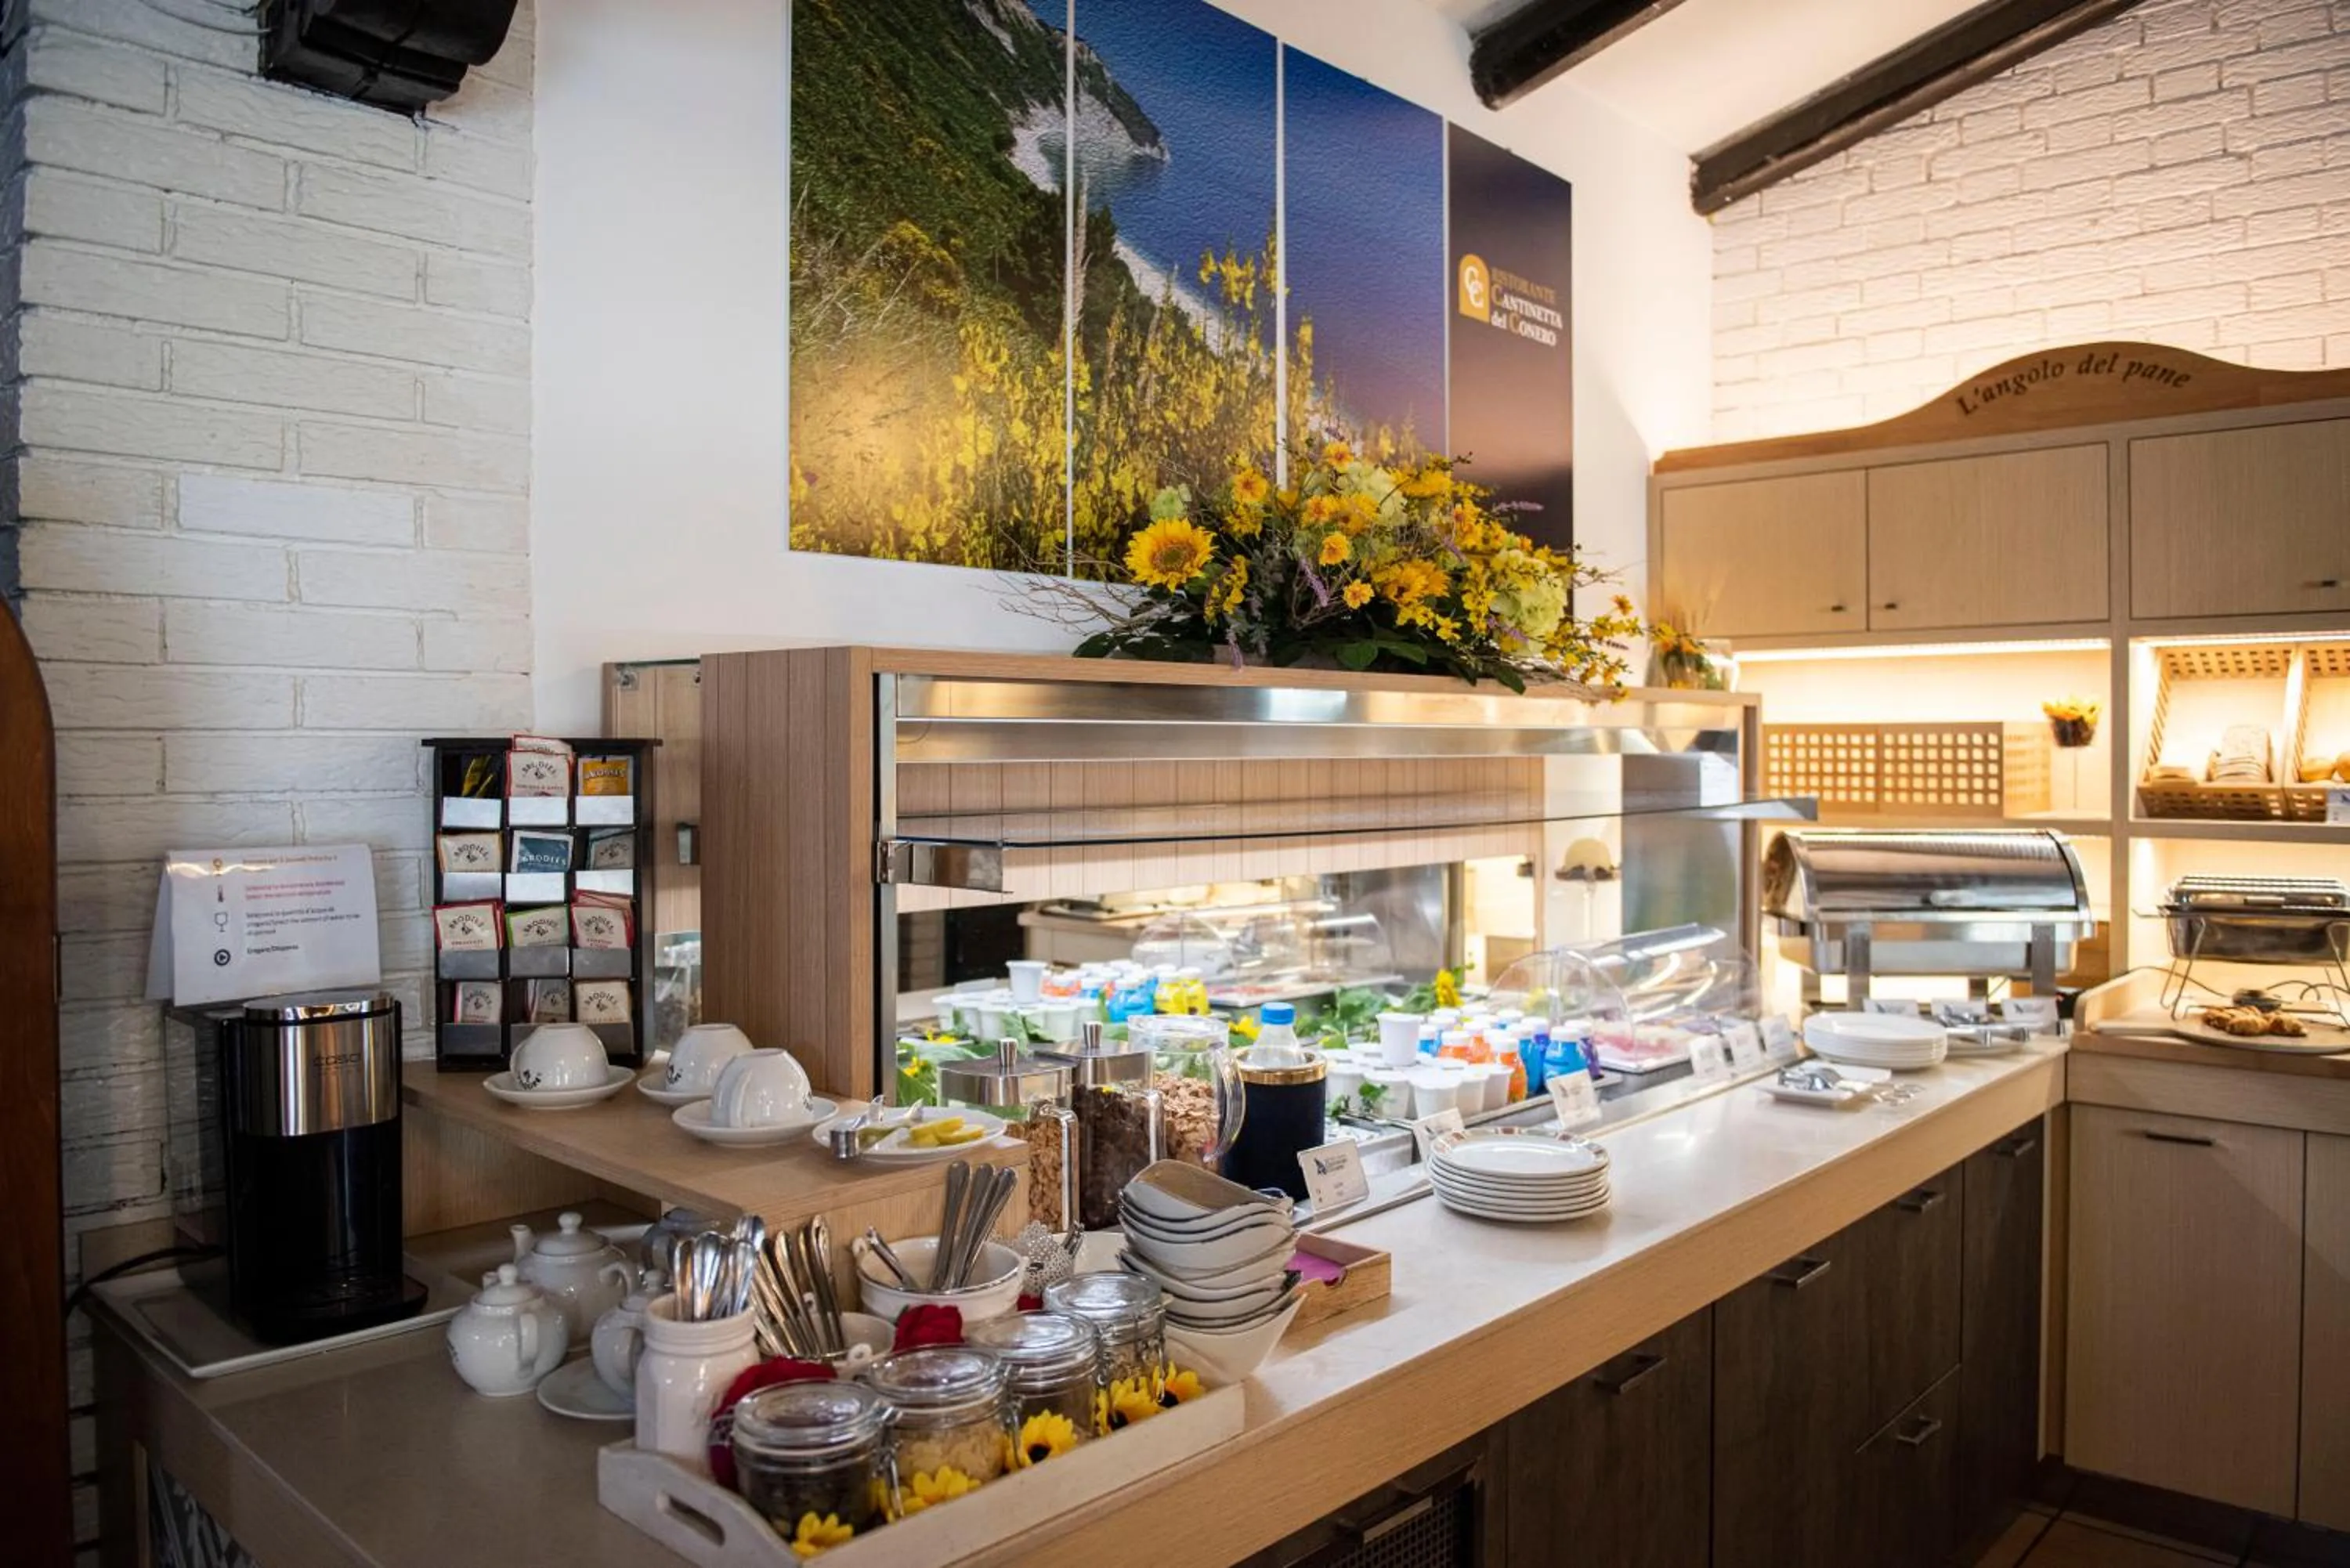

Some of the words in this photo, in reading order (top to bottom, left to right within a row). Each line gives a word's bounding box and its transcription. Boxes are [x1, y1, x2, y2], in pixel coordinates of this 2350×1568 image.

[1491, 284, 1564, 330] CANTINETTA
[1491, 311, 1507, 330] del
[1955, 360, 2065, 416] L'angolo
[2077, 352, 2119, 376] del
[2123, 359, 2193, 388] pane
